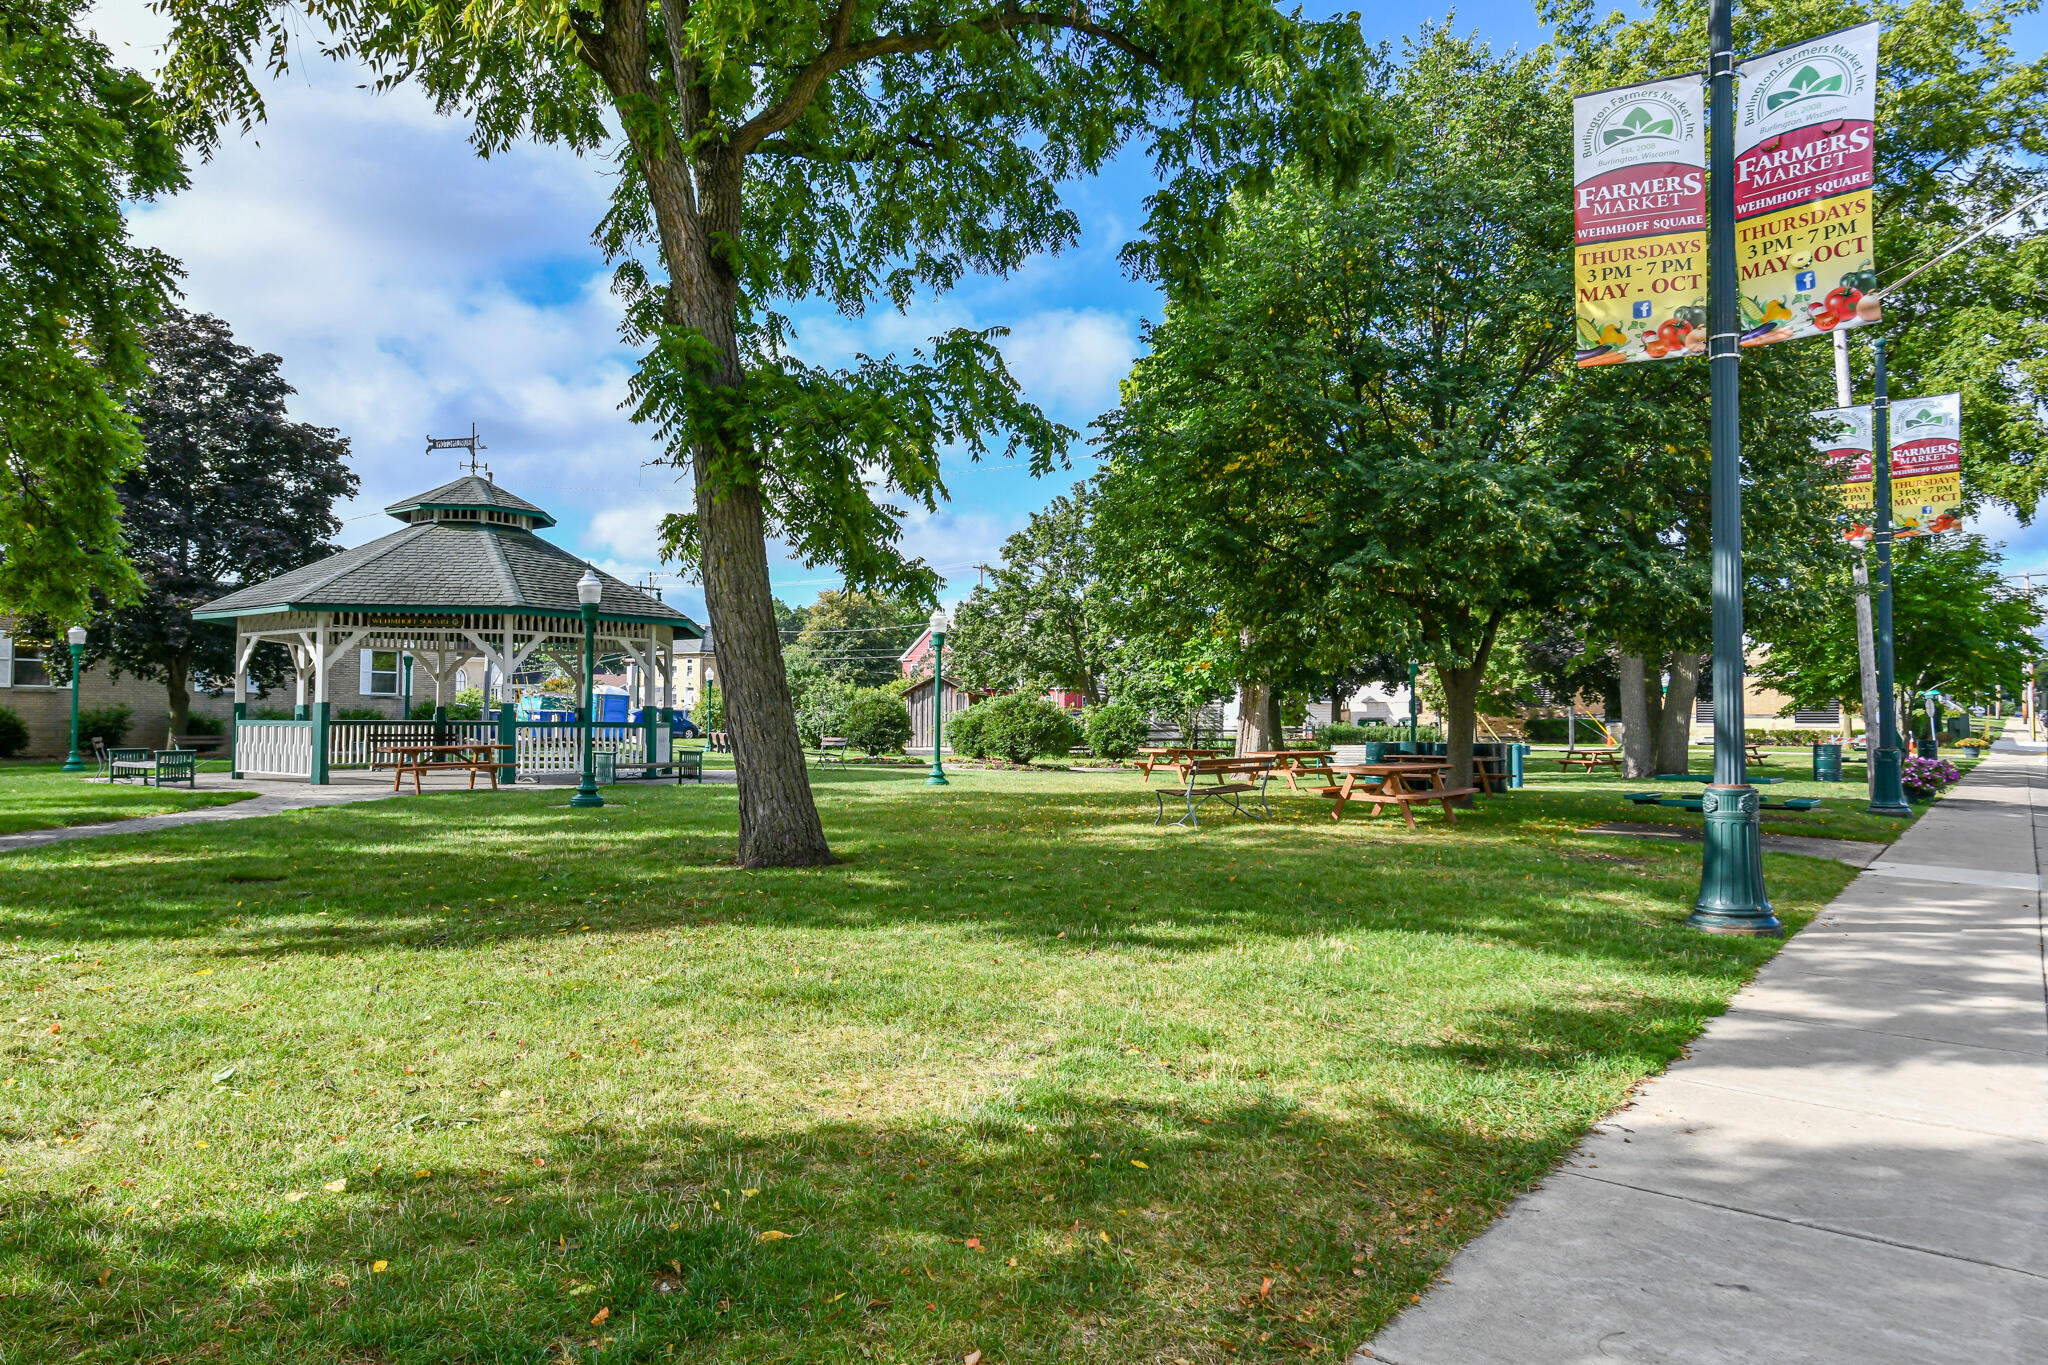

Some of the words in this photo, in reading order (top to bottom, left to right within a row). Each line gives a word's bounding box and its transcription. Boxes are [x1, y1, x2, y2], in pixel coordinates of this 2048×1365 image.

[1745, 69, 1778, 126] Burlington
[1778, 44, 1829, 68] Farmers
[1583, 106, 1611, 158] Burlington
[1610, 90, 1658, 106] Farmers
[1806, 105, 1847, 120] Wisconsin
[1642, 149, 1680, 160] Wisconsin
[1737, 126, 1870, 184] FARMERS
[1752, 149, 1849, 188] MARKET
[1577, 172, 1702, 210] FARMERS
[1592, 191, 1684, 216] MARKET
[1736, 185, 1812, 215] WEHMHOFF
[1815, 172, 1870, 195] SQUARE
[1577, 221, 1650, 239] WEHMHOFF
[1654, 214, 1704, 230] SQUARE
[1739, 198, 1866, 243] THURSDAYS
[1748, 244, 1758, 260] 3
[1762, 234, 1792, 256] PM
[1808, 228, 1819, 244] 7
[1824, 218, 1857, 240] PM
[1579, 239, 1701, 266] THURSDAYS
[1741, 254, 1792, 282] MAY
[1814, 236, 1868, 263] OCT
[1588, 270, 1597, 283] 3
[1601, 264, 1632, 281] PM
[1646, 262, 1656, 276] 7
[1662, 258, 1692, 274] PM
[1579, 282, 1630, 304] MAY
[1652, 274, 1702, 294] OCT
[1892, 442, 1958, 462] FARMERS
[1900, 453, 1946, 464] MARKET
[1931, 464, 1958, 472] SQUARE
[1893, 476, 1957, 489] THURSDAYS
[1905, 488, 1921, 496] PM
[1936, 484, 1952, 493] PM
[1894, 496, 1920, 507] MAY
[1931, 492, 1958, 503] OCT
